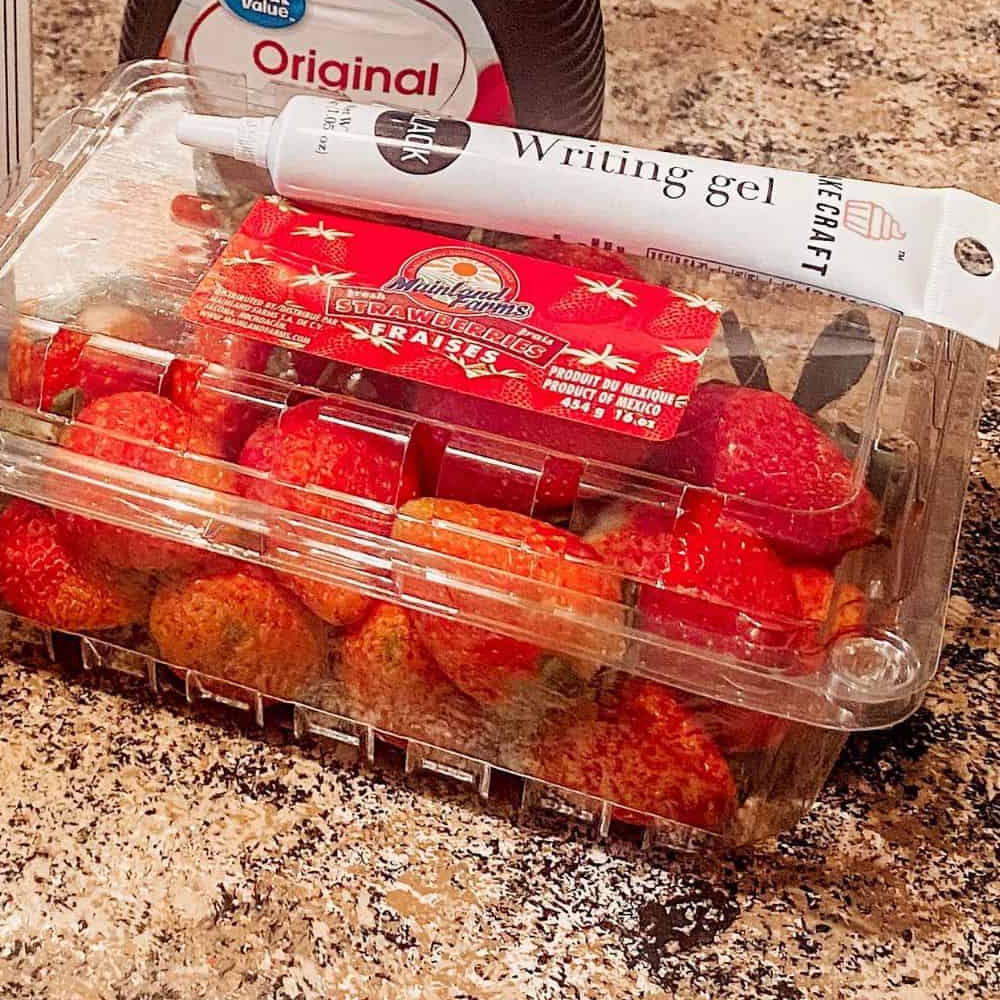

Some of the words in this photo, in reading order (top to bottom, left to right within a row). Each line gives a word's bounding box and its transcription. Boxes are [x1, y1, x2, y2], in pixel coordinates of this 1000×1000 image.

[253, 40, 440, 97] Original
[401, 113, 440, 165] LACK
[512, 131, 694, 200] Writing
[705, 173, 776, 208] gel
[801, 176, 843, 277] KECRAFT
[335, 298, 546, 359] STRAWBERRIES
[370, 322, 500, 364] FRAISES
[542, 379, 598, 401] PRODUCT
[599, 392, 615, 406] OF
[615, 396, 662, 417] MEXICO
[549, 365, 602, 389] PRODUIT
[602, 377, 621, 393] DU
[621, 383, 676, 406] MEXIQUE
[560, 397, 591, 414] 454
[594, 407, 605, 420] g
